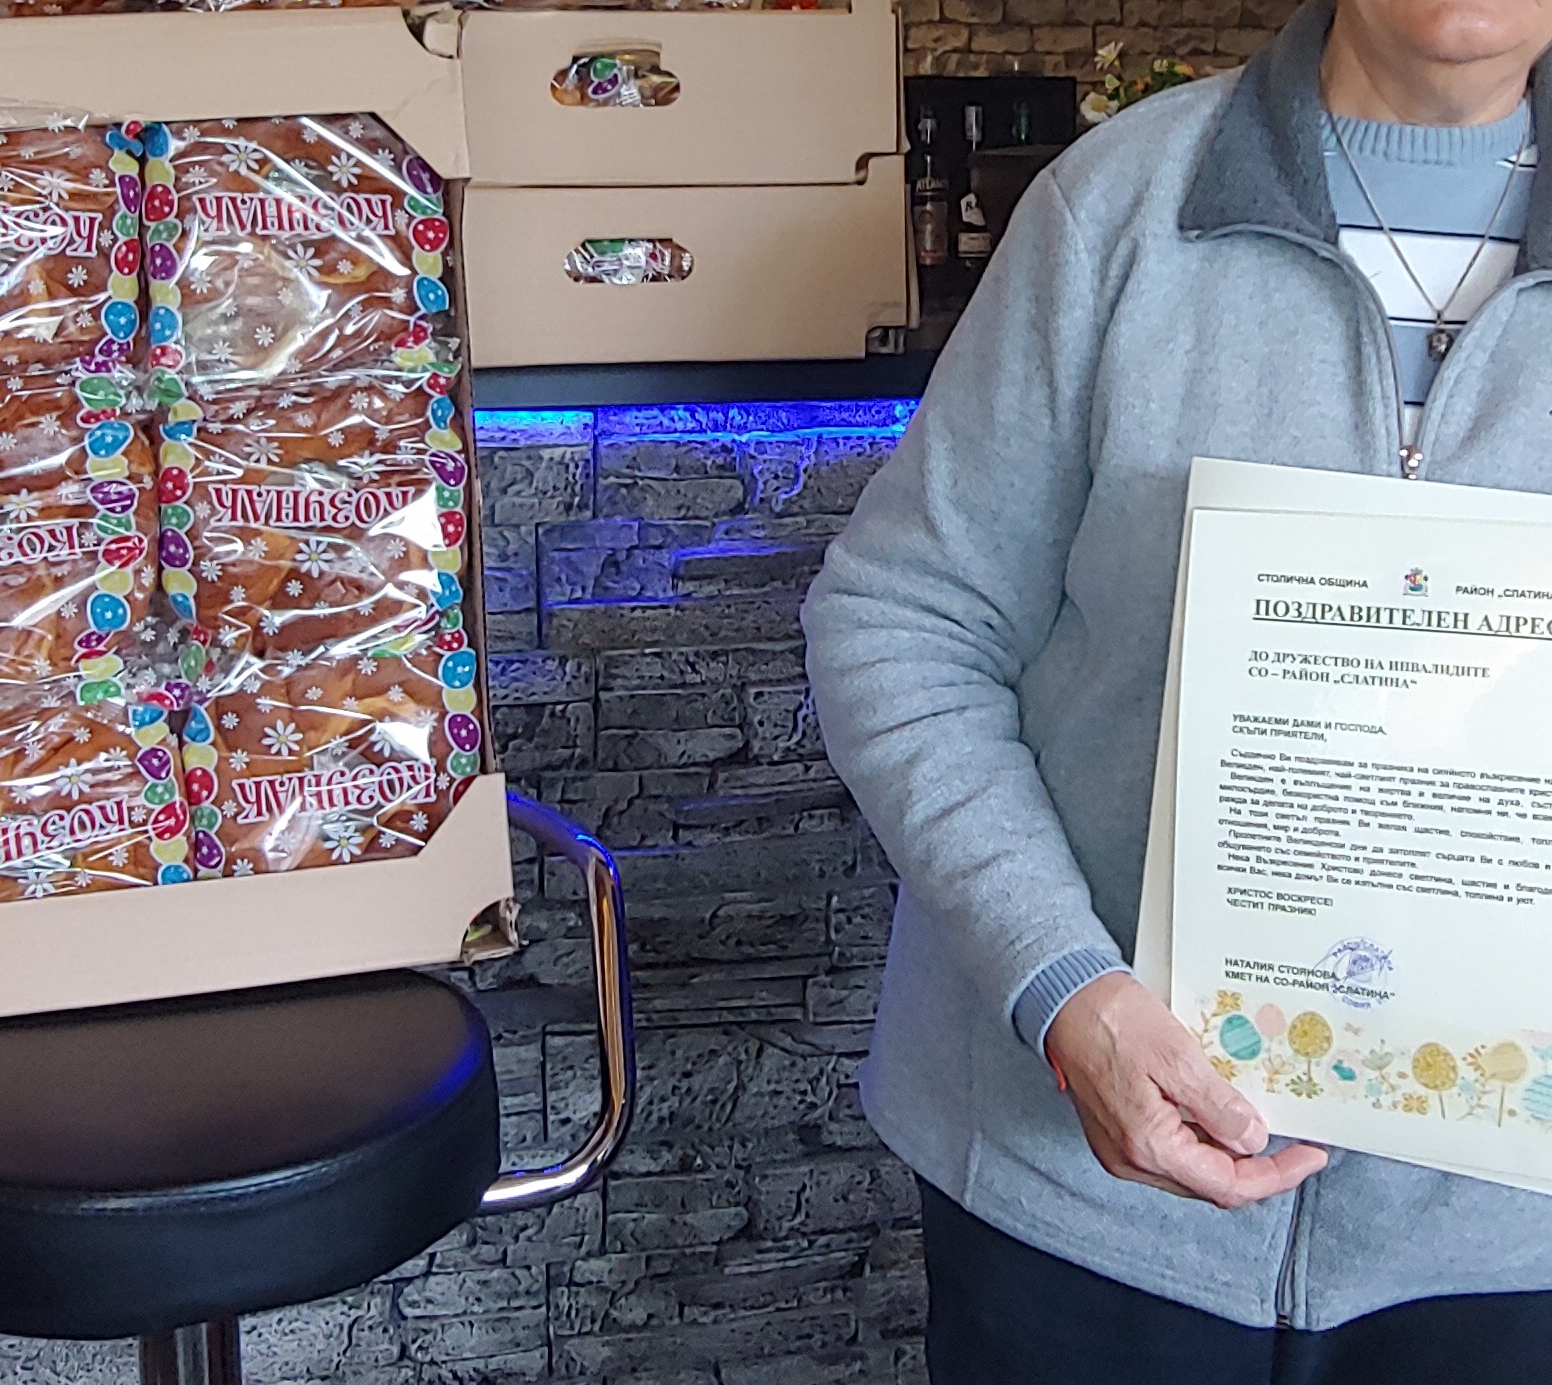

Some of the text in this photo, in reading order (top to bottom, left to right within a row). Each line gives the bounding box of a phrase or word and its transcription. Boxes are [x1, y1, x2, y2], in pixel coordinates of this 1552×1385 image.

[197, 192, 394, 236] КОЗУНАК
[209, 484, 415, 526] КОЗУНАК
[1257, 573, 1368, 589] СТОЛИЧНА ОБЩИНА
[1455, 585, 1494, 596] РАЙОН
[1253, 598, 1470, 631] ПОЗДРАВИТЕЛЕН
[1248, 650, 1491, 679] ДО ДРУЖЕСТВО НА ИНВАЛИДИТЕ
[1248, 666, 1269, 677] СО
[1282, 668, 1330, 683] РАЙОН
[1232, 713, 1387, 736] УВАЖАЕМИ ДАМИ И ГОСПОДА,
[1232, 725, 1268, 736] СКЪПИ
[1227, 886, 1273, 899] ХРИСТОС
[1227, 897, 1264, 910] ЧЕСТИТ
[1225, 957, 1275, 972] НАТАЛИЯ
[1225, 970, 1253, 982] КМЕТ
[1255, 975, 1270, 983] НА
[1273, 977, 1329, 992] СО-РАЙОН
